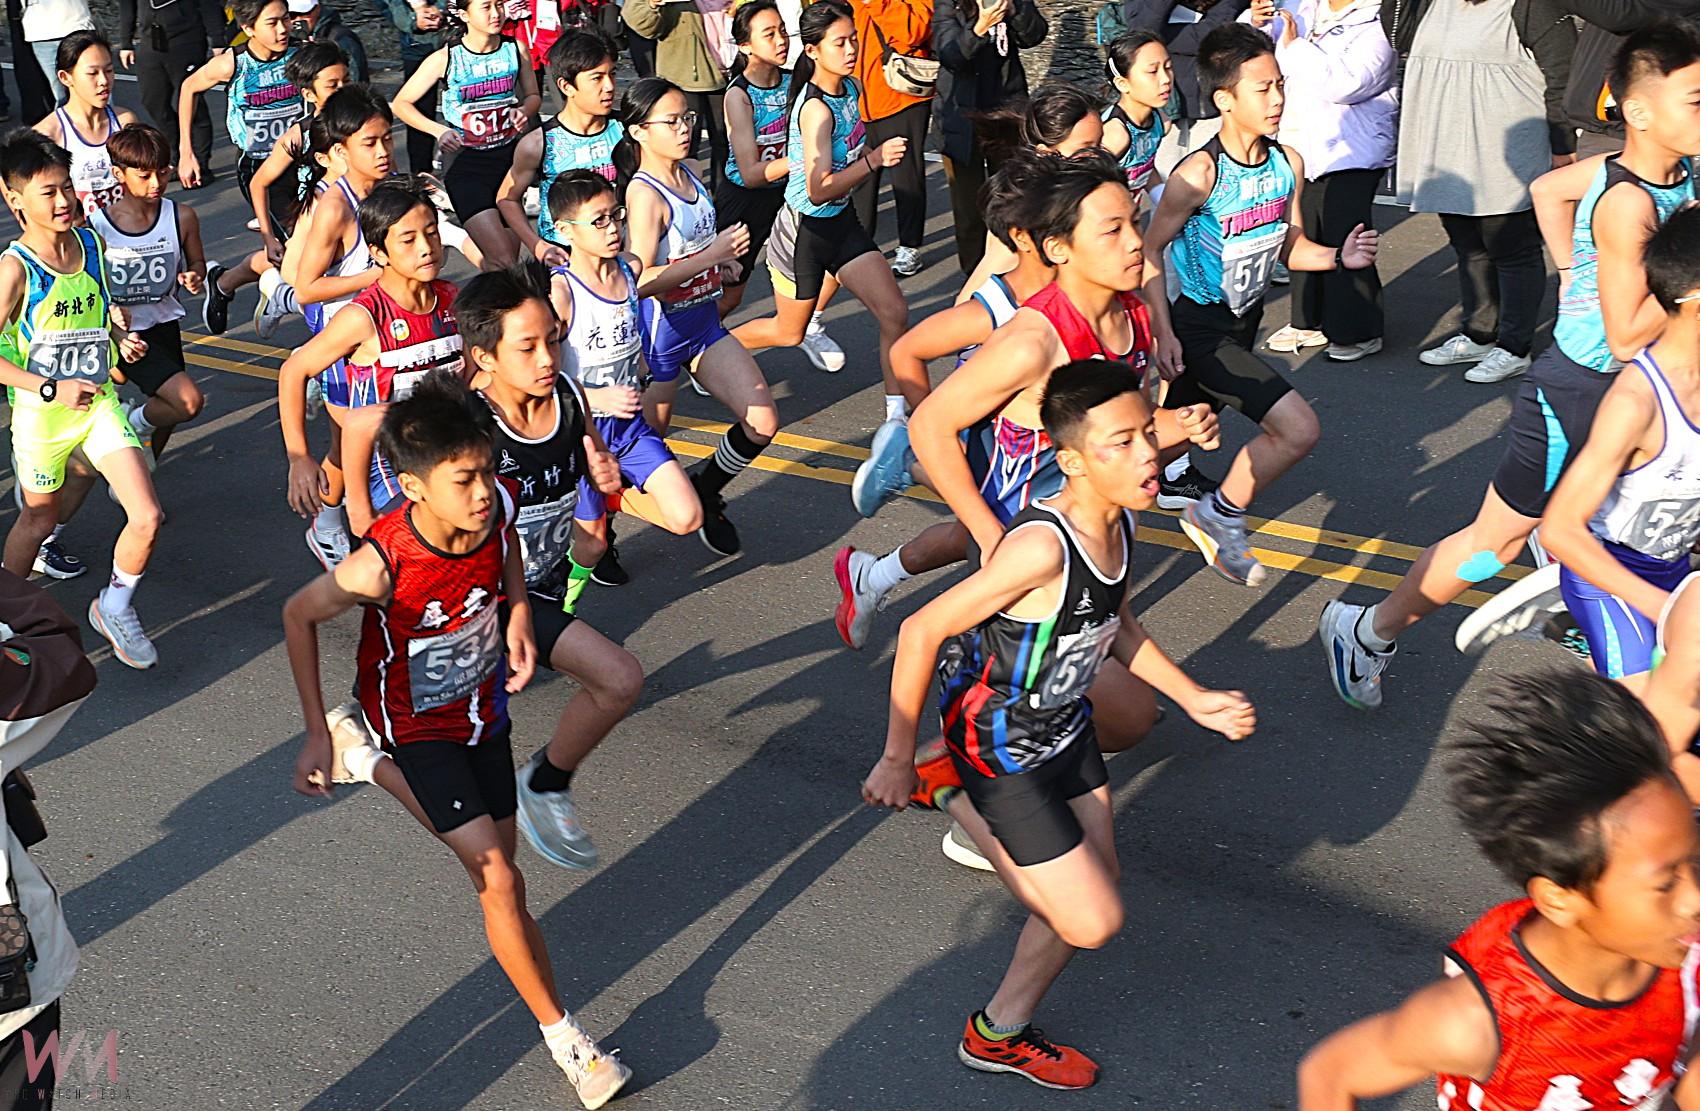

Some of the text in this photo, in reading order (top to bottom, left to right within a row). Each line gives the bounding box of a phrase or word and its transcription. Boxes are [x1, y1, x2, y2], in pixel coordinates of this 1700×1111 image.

[82, 184, 125, 217] 638
[111, 256, 167, 285] 526
[54, 292, 97, 318] 新北市
[38, 343, 100, 378] 503
